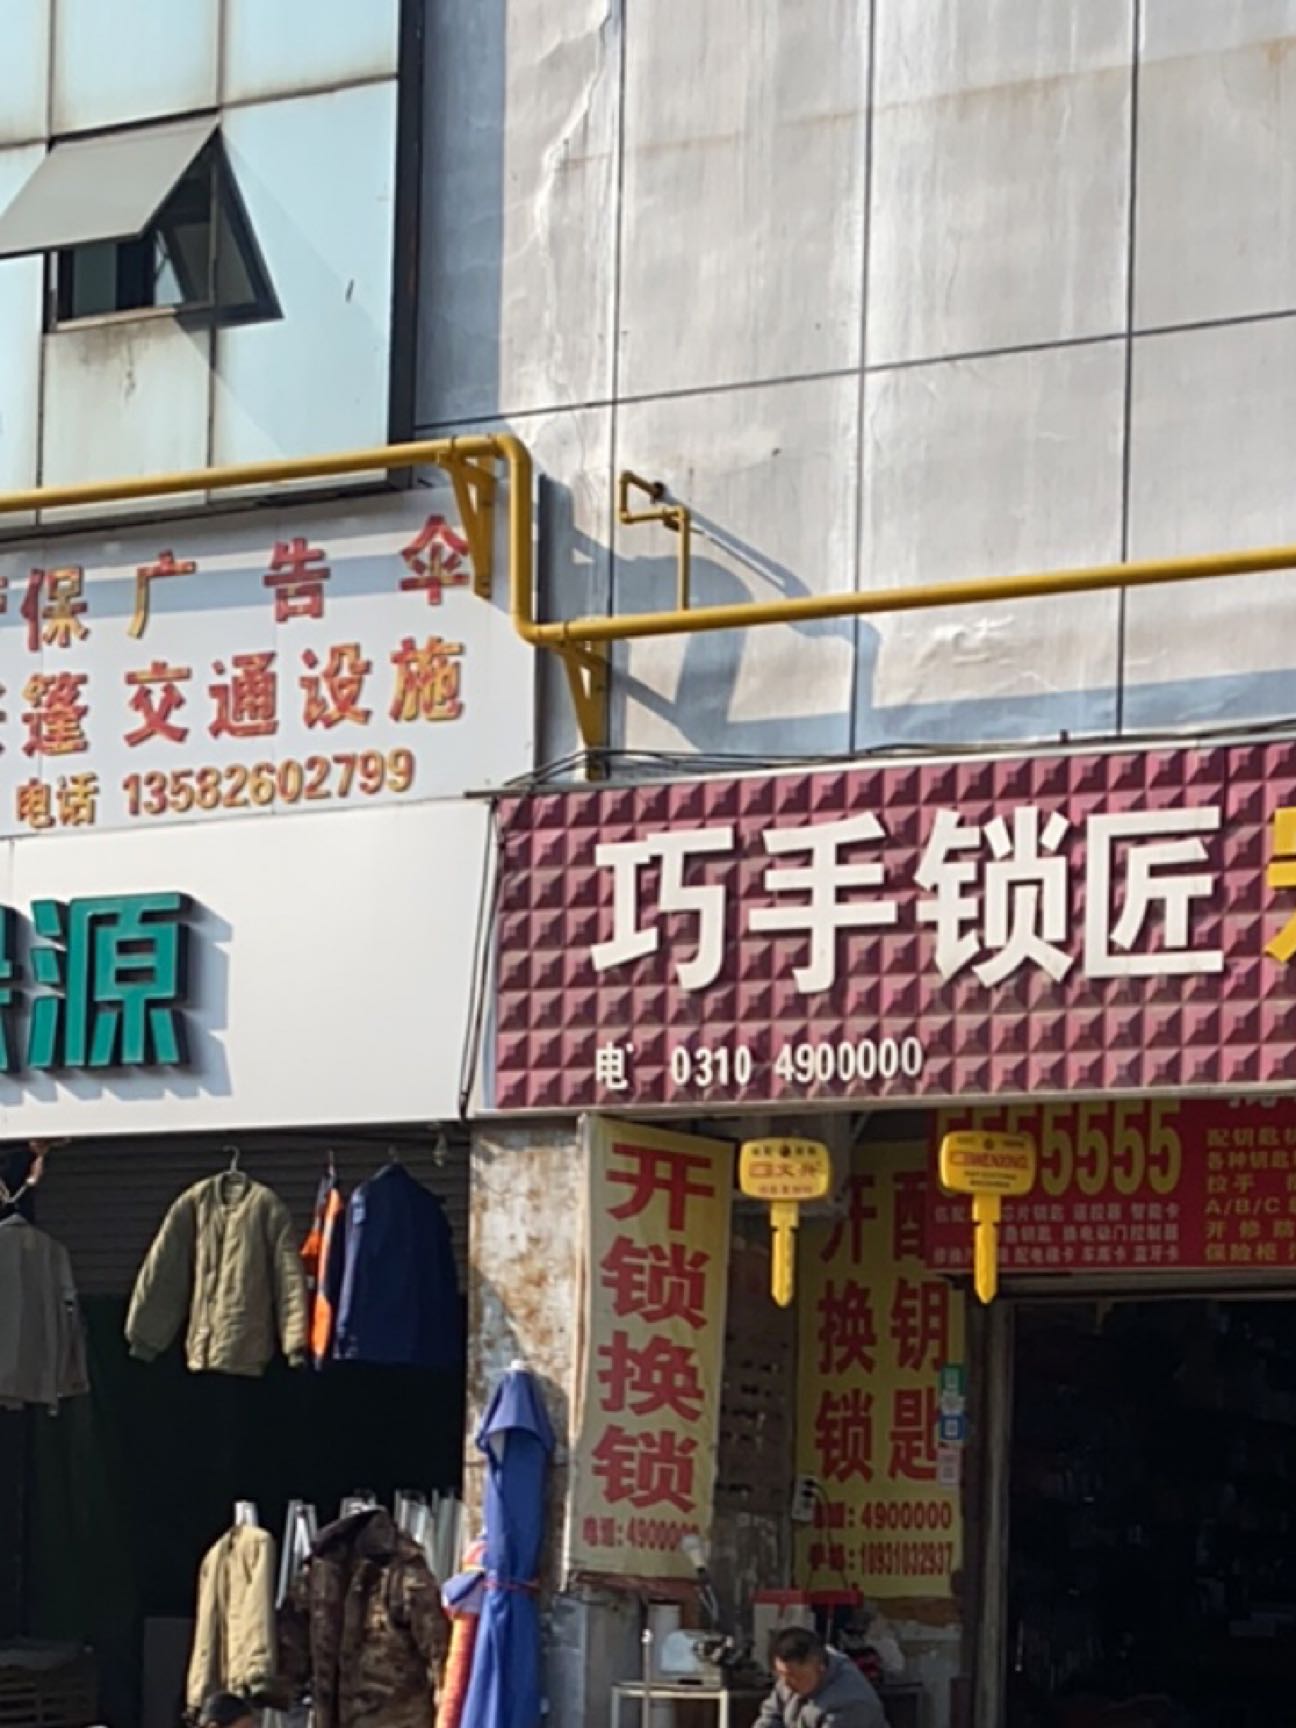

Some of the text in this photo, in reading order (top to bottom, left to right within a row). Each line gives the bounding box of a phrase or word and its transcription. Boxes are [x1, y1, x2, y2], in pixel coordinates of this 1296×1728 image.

[16, 747, 416, 829] 电话 13582602799
[0, 891, 183, 1070] 源
[591, 805, 1224, 994] 巧手锁匠
[670, 1045, 751, 1087] 0310
[773, 1037, 922, 1084] 4900000
[593, 1143, 712, 1512] 开锁换锁
